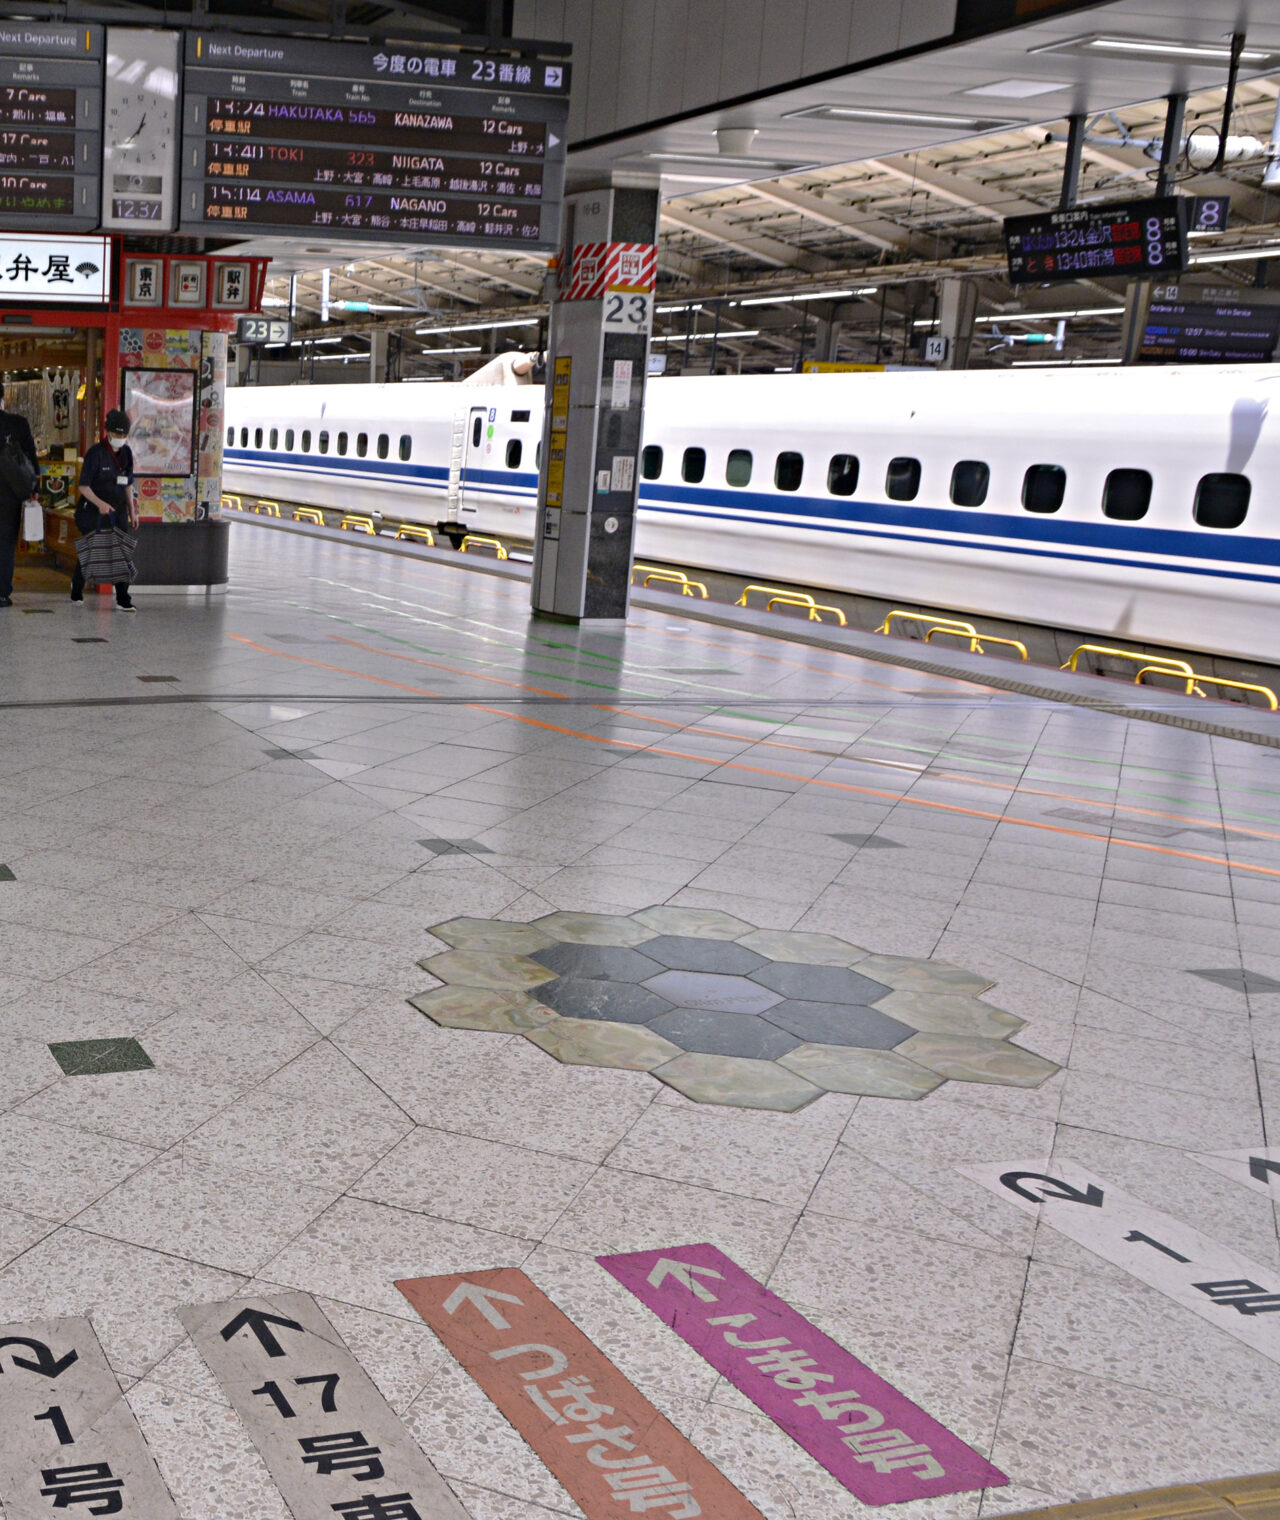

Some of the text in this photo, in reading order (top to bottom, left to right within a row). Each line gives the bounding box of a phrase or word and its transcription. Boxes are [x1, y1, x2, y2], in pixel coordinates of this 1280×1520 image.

[24, 32, 78, 46] Departure
[209, 43, 284, 61] Next Departure
[373, 52, 532, 85] 今度の電車 23番線
[6, 88, 15, 101] 7
[268, 104, 344, 123] HAKUTAKA
[394, 112, 454, 130] KANAZAWA
[483, 120, 495, 133] 12
[498, 121, 523, 136] Cars
[2, 133, 17, 145] 17
[267, 146, 305, 161] TOKI
[347, 152, 375, 167] 323
[392, 154, 445, 172] NIIGATA
[479, 161, 492, 175] 12
[495, 163, 520, 177] Cars
[265, 191, 316, 205] ASAMA
[390, 196, 447, 214] NAGANO
[477, 203, 491, 217] 12
[493, 204, 518, 219] Cars
[1200, 200, 1220, 225] 8
[1086, 224, 1113, 245] 金沢
[1146, 217, 1162, 242] 8
[1147, 241, 1163, 265] 8
[138, 267, 153, 297] 東京
[226, 270, 241, 299] 駅弁
[1167, 287, 1177, 299] 14
[605, 294, 648, 324] 23
[245, 320, 268, 339] 23
[928, 342, 942, 356] 14
[707, 1311, 948, 1483] こまち号
[489, 1342, 704, 1520] つばさ号
